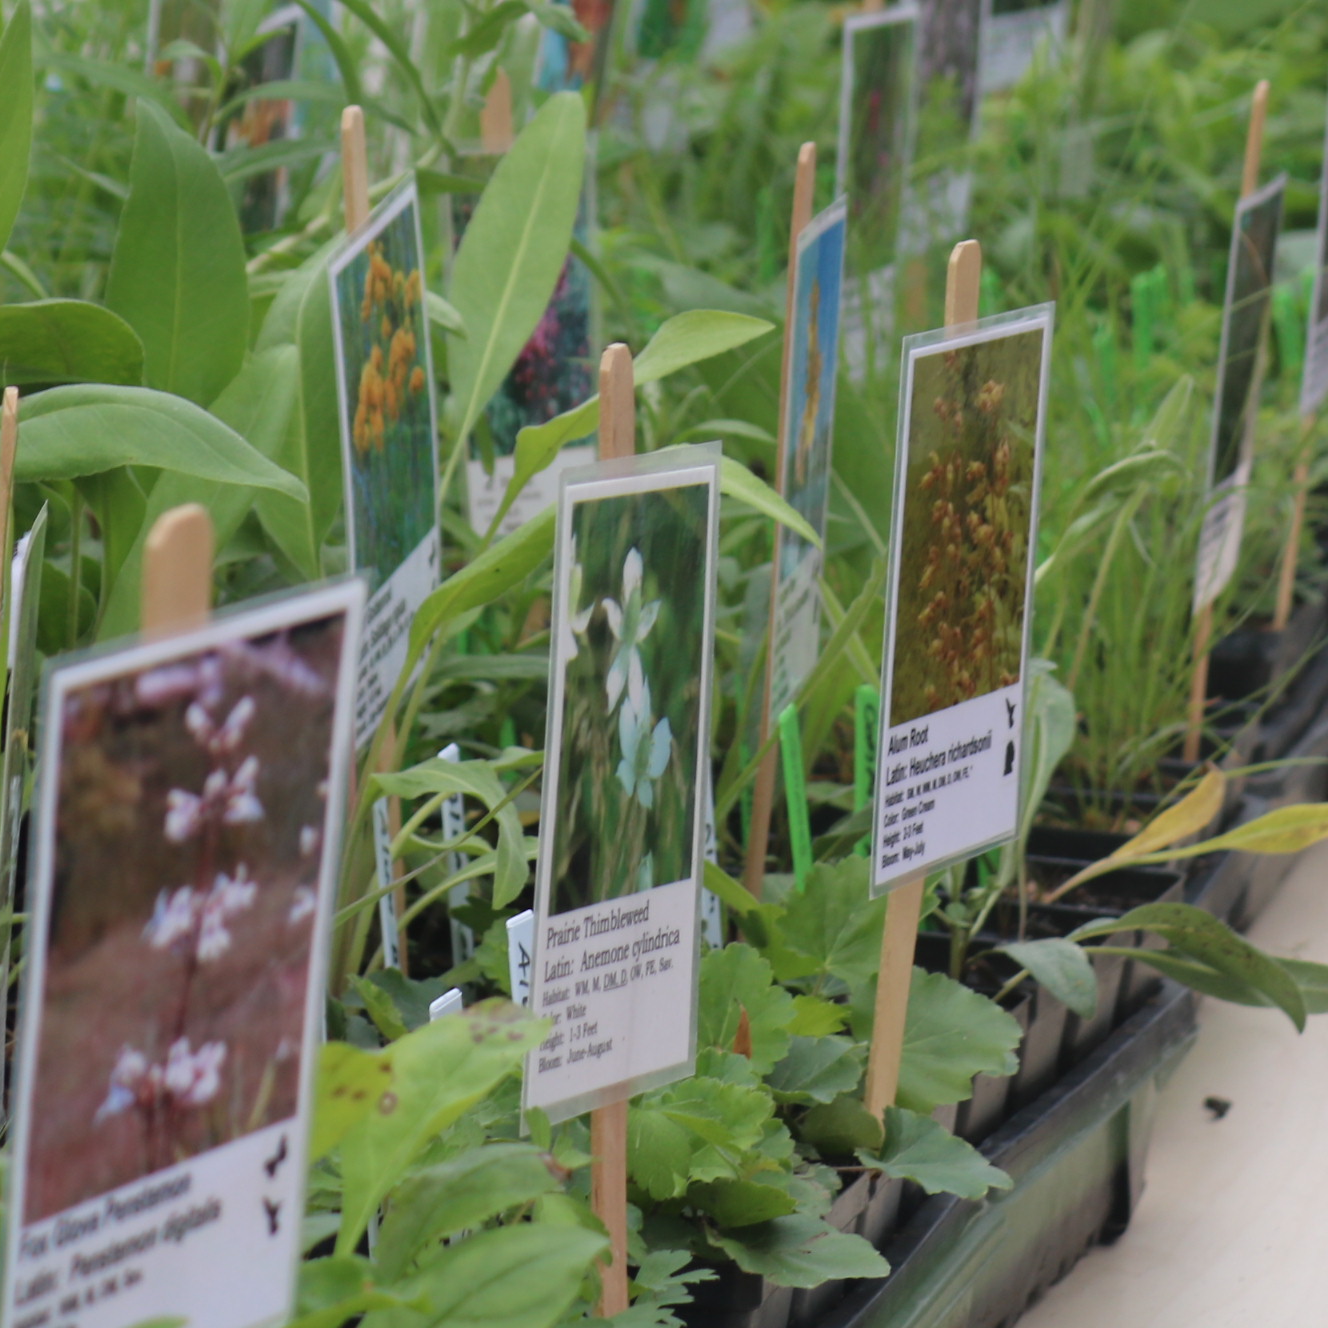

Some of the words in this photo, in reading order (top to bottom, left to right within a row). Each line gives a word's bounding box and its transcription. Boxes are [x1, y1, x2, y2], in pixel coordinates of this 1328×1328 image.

[888, 734, 908, 756] Alum
[909, 725, 928, 747] Root
[886, 762, 908, 787] Latin:
[909, 749, 946, 777] Heuchera
[947, 729, 992, 764] richardsonii
[546, 921, 580, 950] Prairie
[584, 900, 649, 937] Thimbleweed
[544, 956, 574, 983] Latin:
[581, 944, 630, 972] Anemone
[632, 923, 681, 963] cylindrica
[575, 979, 590, 997] WM,
[592, 976, 602, 992] M,
[566, 1003, 587, 1021] White
[570, 1026, 583, 1042] 1-3
[583, 1022, 599, 1038] Feet
[538, 1053, 563, 1074] Bloom:
[567, 1039, 613, 1065] June-August
